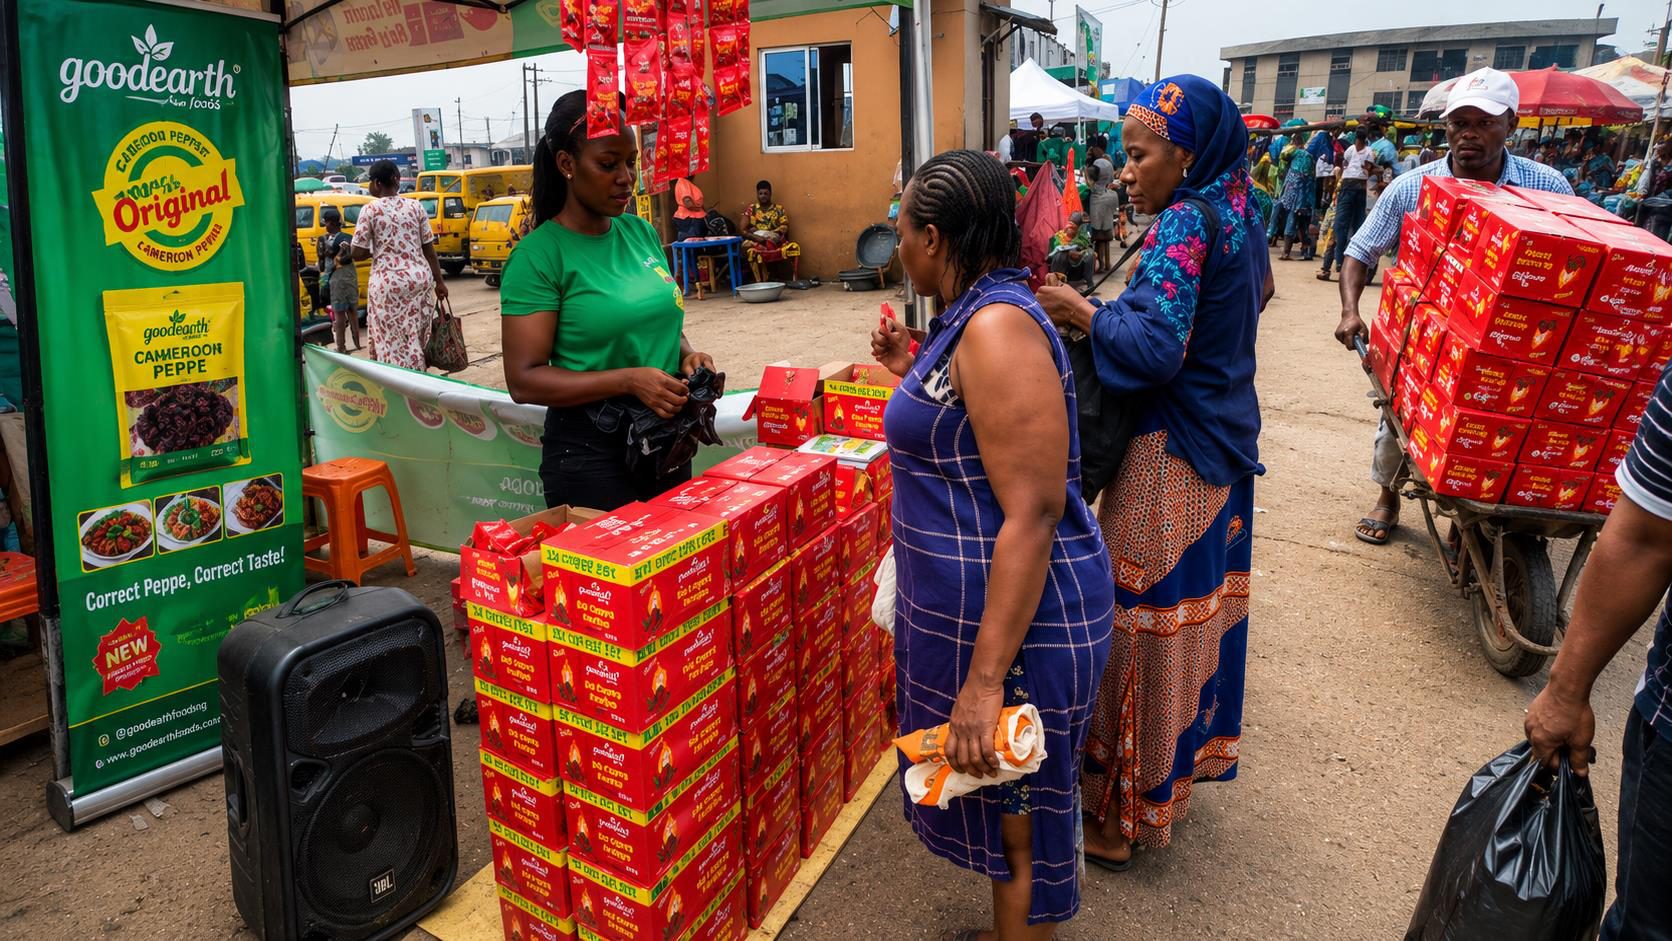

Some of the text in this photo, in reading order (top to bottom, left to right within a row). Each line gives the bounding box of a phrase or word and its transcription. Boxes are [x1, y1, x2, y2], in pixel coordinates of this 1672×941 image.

[59, 53, 237, 104] goodearth
[113, 168, 232, 233] Original
[134, 343, 223, 364] CAMEROON
[153, 359, 207, 380] PEPPE
[85, 546, 286, 611] Correct Peppe, Correct Taste!
[105, 634, 148, 669] NEW
